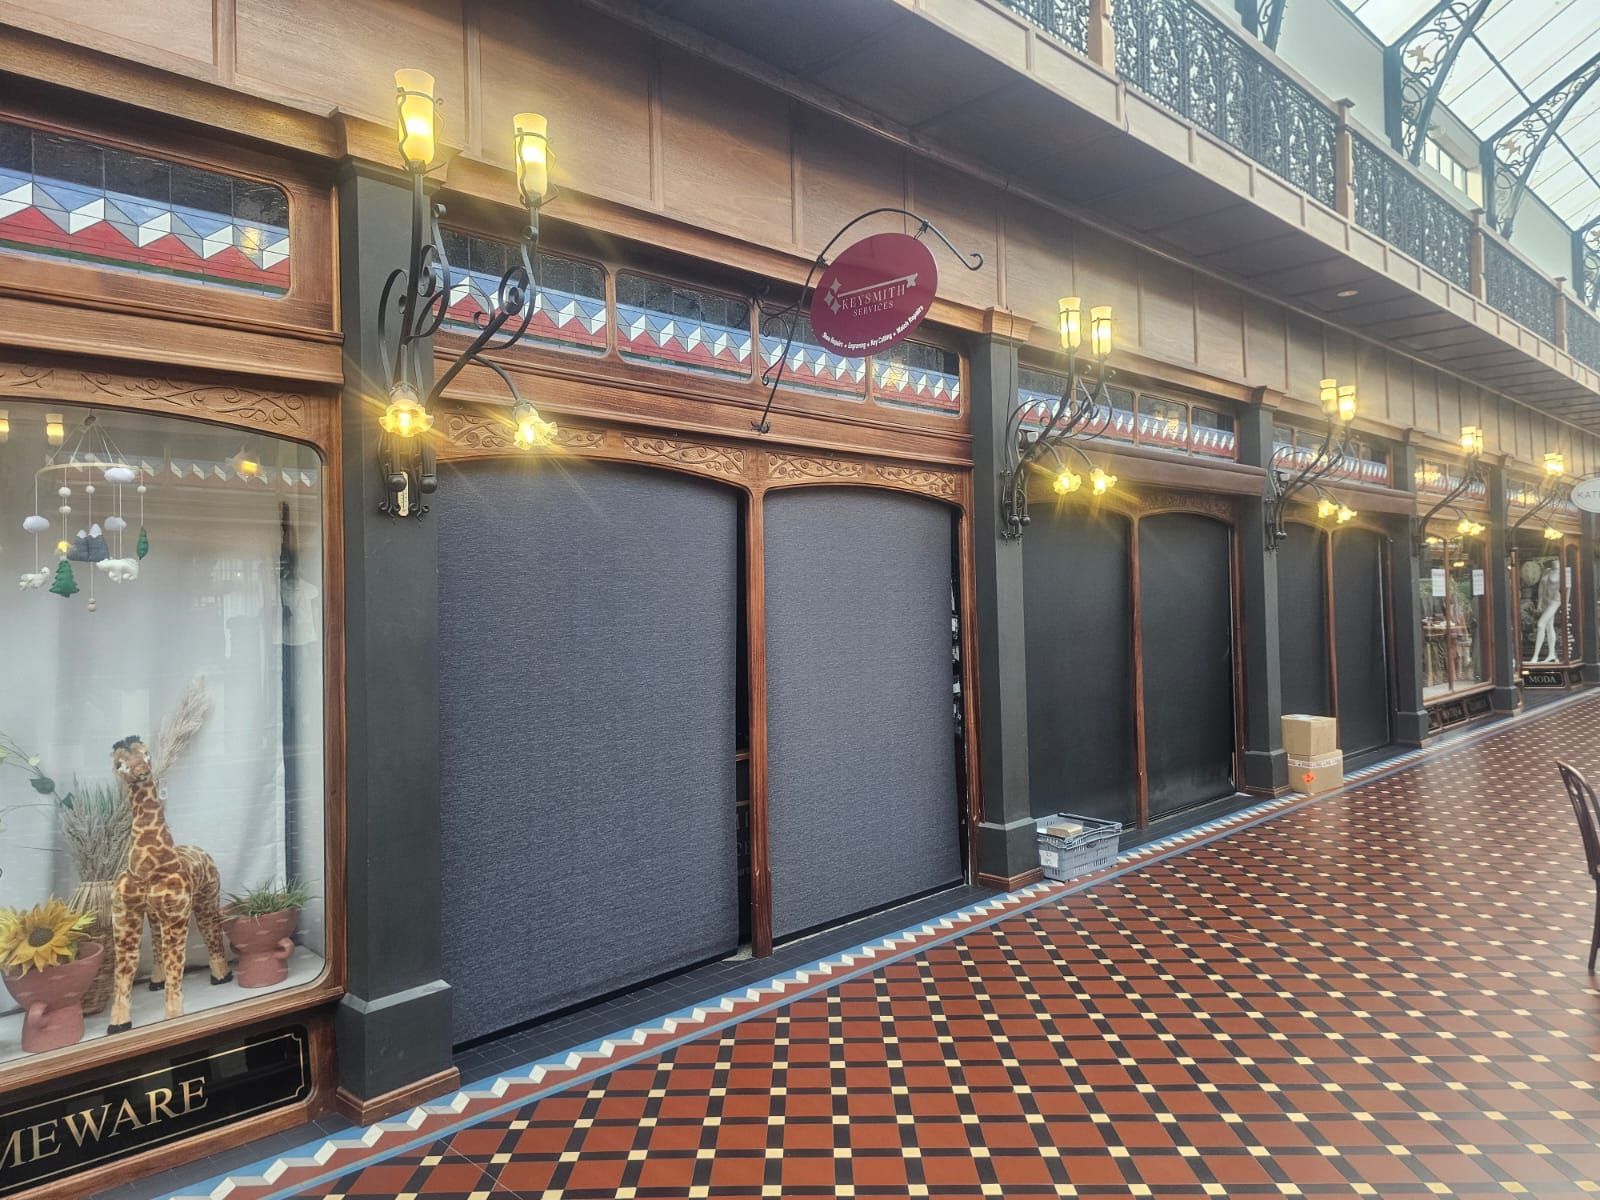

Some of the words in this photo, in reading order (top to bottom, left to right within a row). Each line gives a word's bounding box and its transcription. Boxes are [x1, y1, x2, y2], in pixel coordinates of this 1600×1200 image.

[842, 284, 906, 311] KEYSMITH
[853, 301, 894, 317] SERVICES
[870, 339, 878, 347] Key
[878, 333, 893, 344] Cutting
[896, 321, 909, 334] Watch
[908, 305, 924, 323] Repairs
[1576, 490, 1600, 499] KAT
[1528, 675, 1557, 684] MODA
